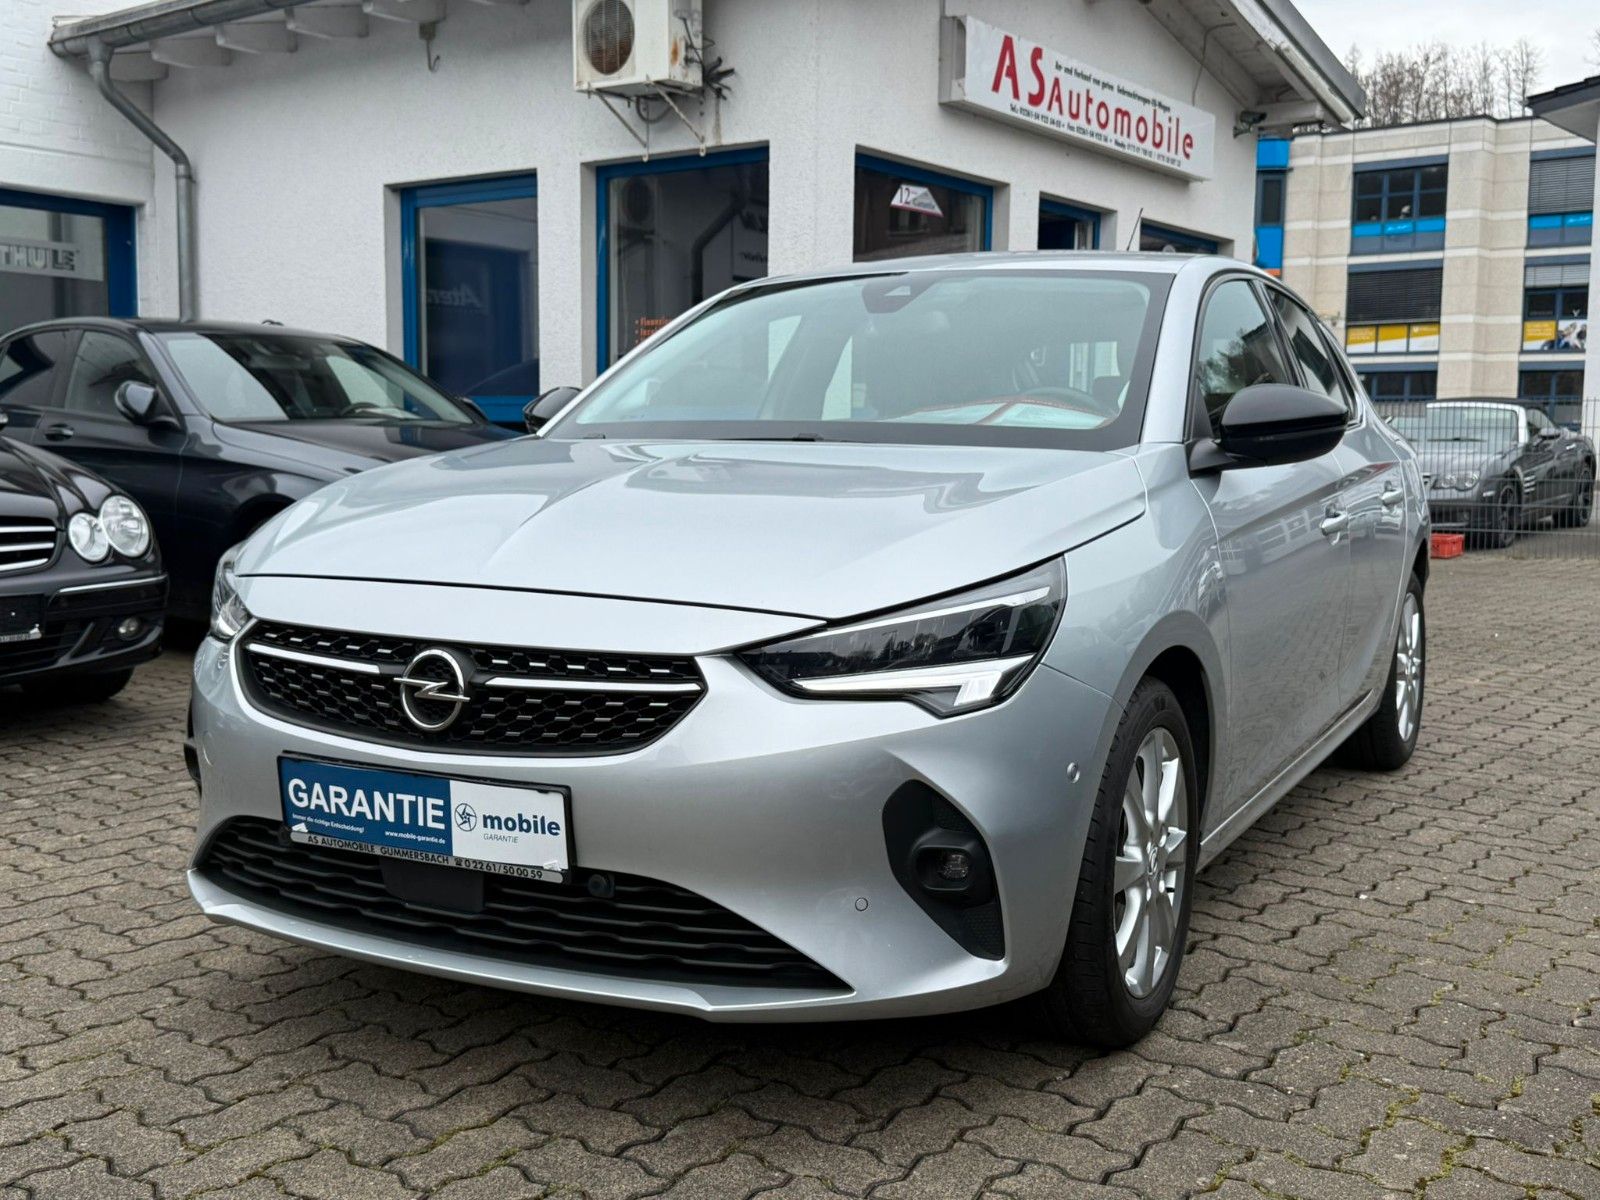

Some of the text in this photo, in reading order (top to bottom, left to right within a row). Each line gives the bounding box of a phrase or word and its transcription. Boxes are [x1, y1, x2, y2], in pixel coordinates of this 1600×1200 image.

[1047, 77, 1194, 160] Automobile
[900, 186, 910, 204] 12
[288, 778, 446, 830] GARANTIE
[314, 818, 331, 827] richtige
[482, 813, 561, 836] mobile
[385, 830, 446, 844] www.mobile-garantie.de
[483, 833, 519, 843] GARANTIE
[307, 835, 319, 844] AS
[321, 838, 376, 854] AUTOMOBILE
[380, 846, 449, 865] GUMMERSBACH
